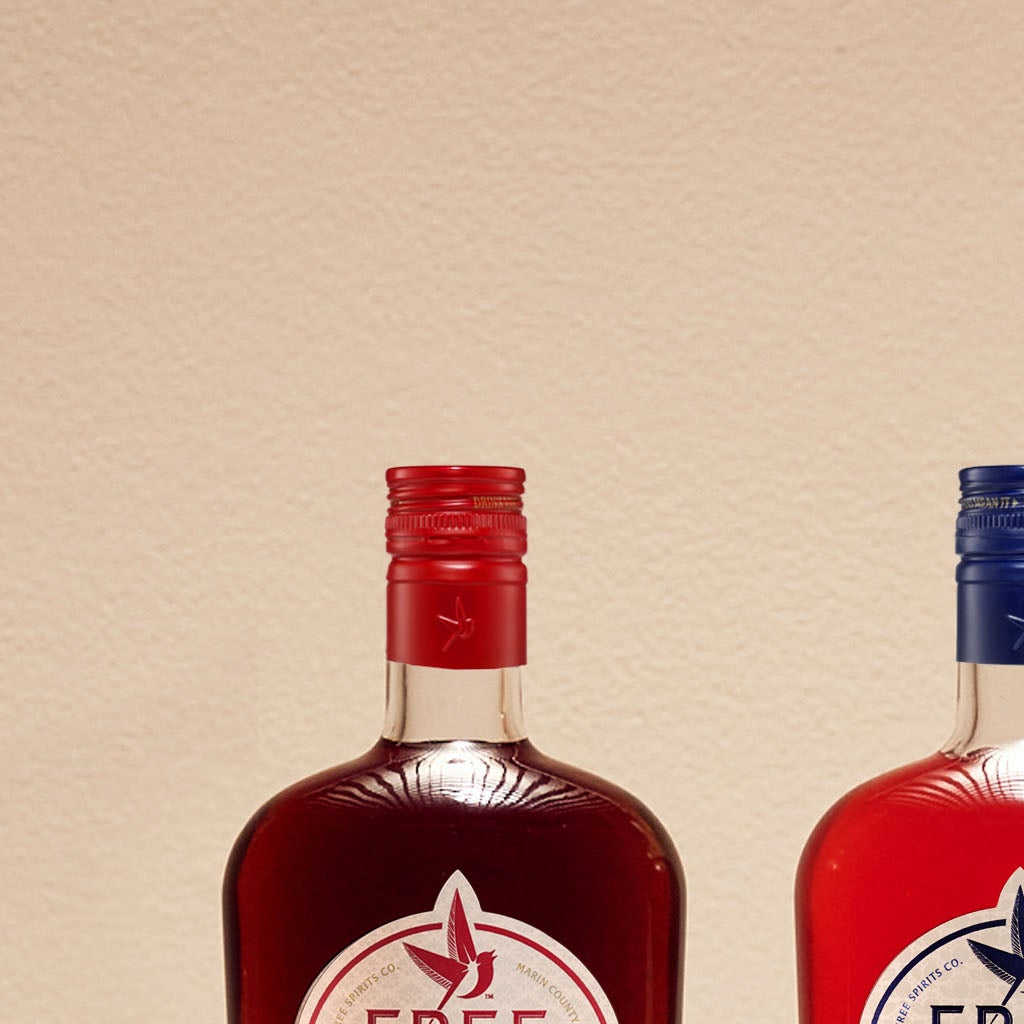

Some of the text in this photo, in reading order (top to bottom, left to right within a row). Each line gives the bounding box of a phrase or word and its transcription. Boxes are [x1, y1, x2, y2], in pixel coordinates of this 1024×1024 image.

[344, 973, 380, 1008] SPIRITS
[380, 963, 401, 977] CO.
[516, 962, 550, 988] MARIN
[908, 968, 943, 1002] SPIRITS
[943, 958, 964, 972] CO.
